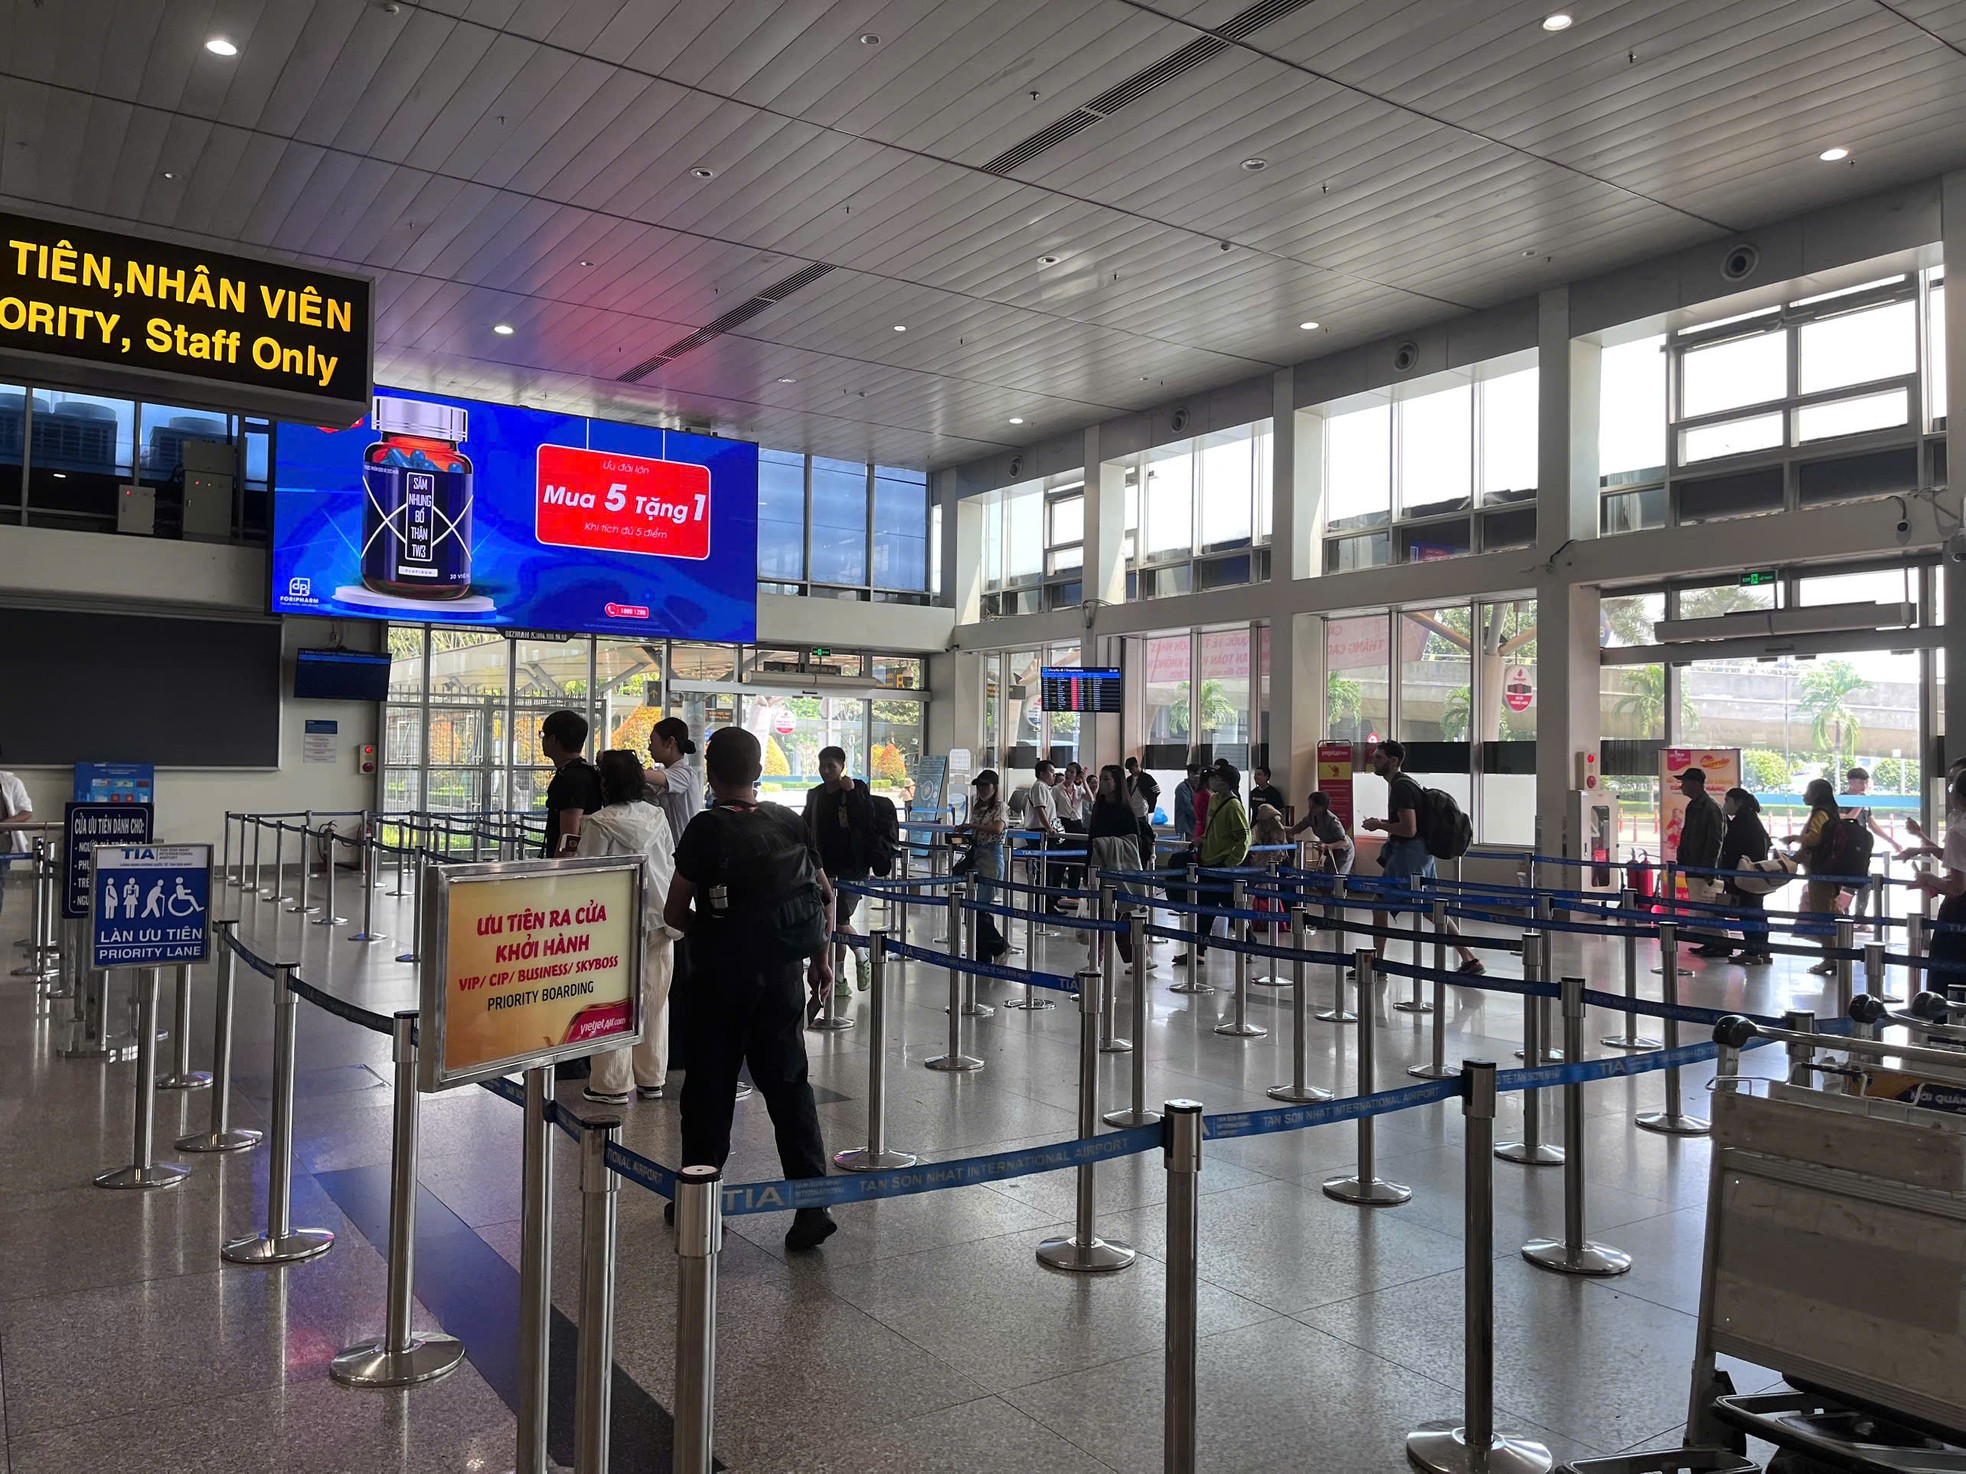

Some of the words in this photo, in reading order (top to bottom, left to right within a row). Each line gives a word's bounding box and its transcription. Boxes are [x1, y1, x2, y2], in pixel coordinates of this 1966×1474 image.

[259, 286, 352, 332] VIÊN
[145, 318, 241, 364] Staff
[252, 337, 338, 387] Only
[413, 476, 428, 490] SÂM
[408, 493, 432, 507] NHUNG
[542, 484, 596, 509] Mua
[604, 483, 627, 512] 5
[635, 495, 688, 524] Tặng
[693, 493, 707, 521] 1
[585, 522, 600, 532] Khi
[601, 523, 619, 534] tích
[635, 527, 642, 537] 5
[412, 544, 426, 558] TW3
[279, 595, 319, 604] FORIPHARM
[74, 812, 87, 835] CỬA
[88, 815, 98, 835] ƯU
[98, 814, 112, 834] TIÊN
[112, 814, 129, 835] DÀNH
[121, 848, 155, 860] TIA
[477, 914, 503, 936] ƯU
[507, 908, 545, 933] TIÊN
[549, 909, 571, 928] RA
[575, 899, 607, 925] CỬA
[100, 927, 133, 943] LÀN
[139, 927, 161, 942] ƯU
[166, 925, 203, 941] TIÊN
[99, 947, 163, 960] PRIORITY
[167, 946, 202, 957] LANE
[495, 934, 538, 964] KHỞI
[542, 933, 590, 957] HÀNH
[459, 975, 486, 992] VIP/
[489, 970, 515, 988] CIP/
[518, 962, 574, 983] BUSINESS/
[576, 955, 619, 974] SKYBOSS
[1059, 978, 1079, 990] TIA
[487, 989, 540, 1011] PRIORITY
[542, 981, 594, 1002] BOARDING
[1600, 1058, 1627, 1075] TIA
[859, 1179, 887, 1192] TAN
[891, 1174, 922, 1190] SON
[926, 1168, 965, 1184] NHAT
[967, 1151, 1071, 1178] INTERNATIONAL
[1076, 1137, 1128, 1161] AIRPORT
[723, 1186, 785, 1212] TIA
